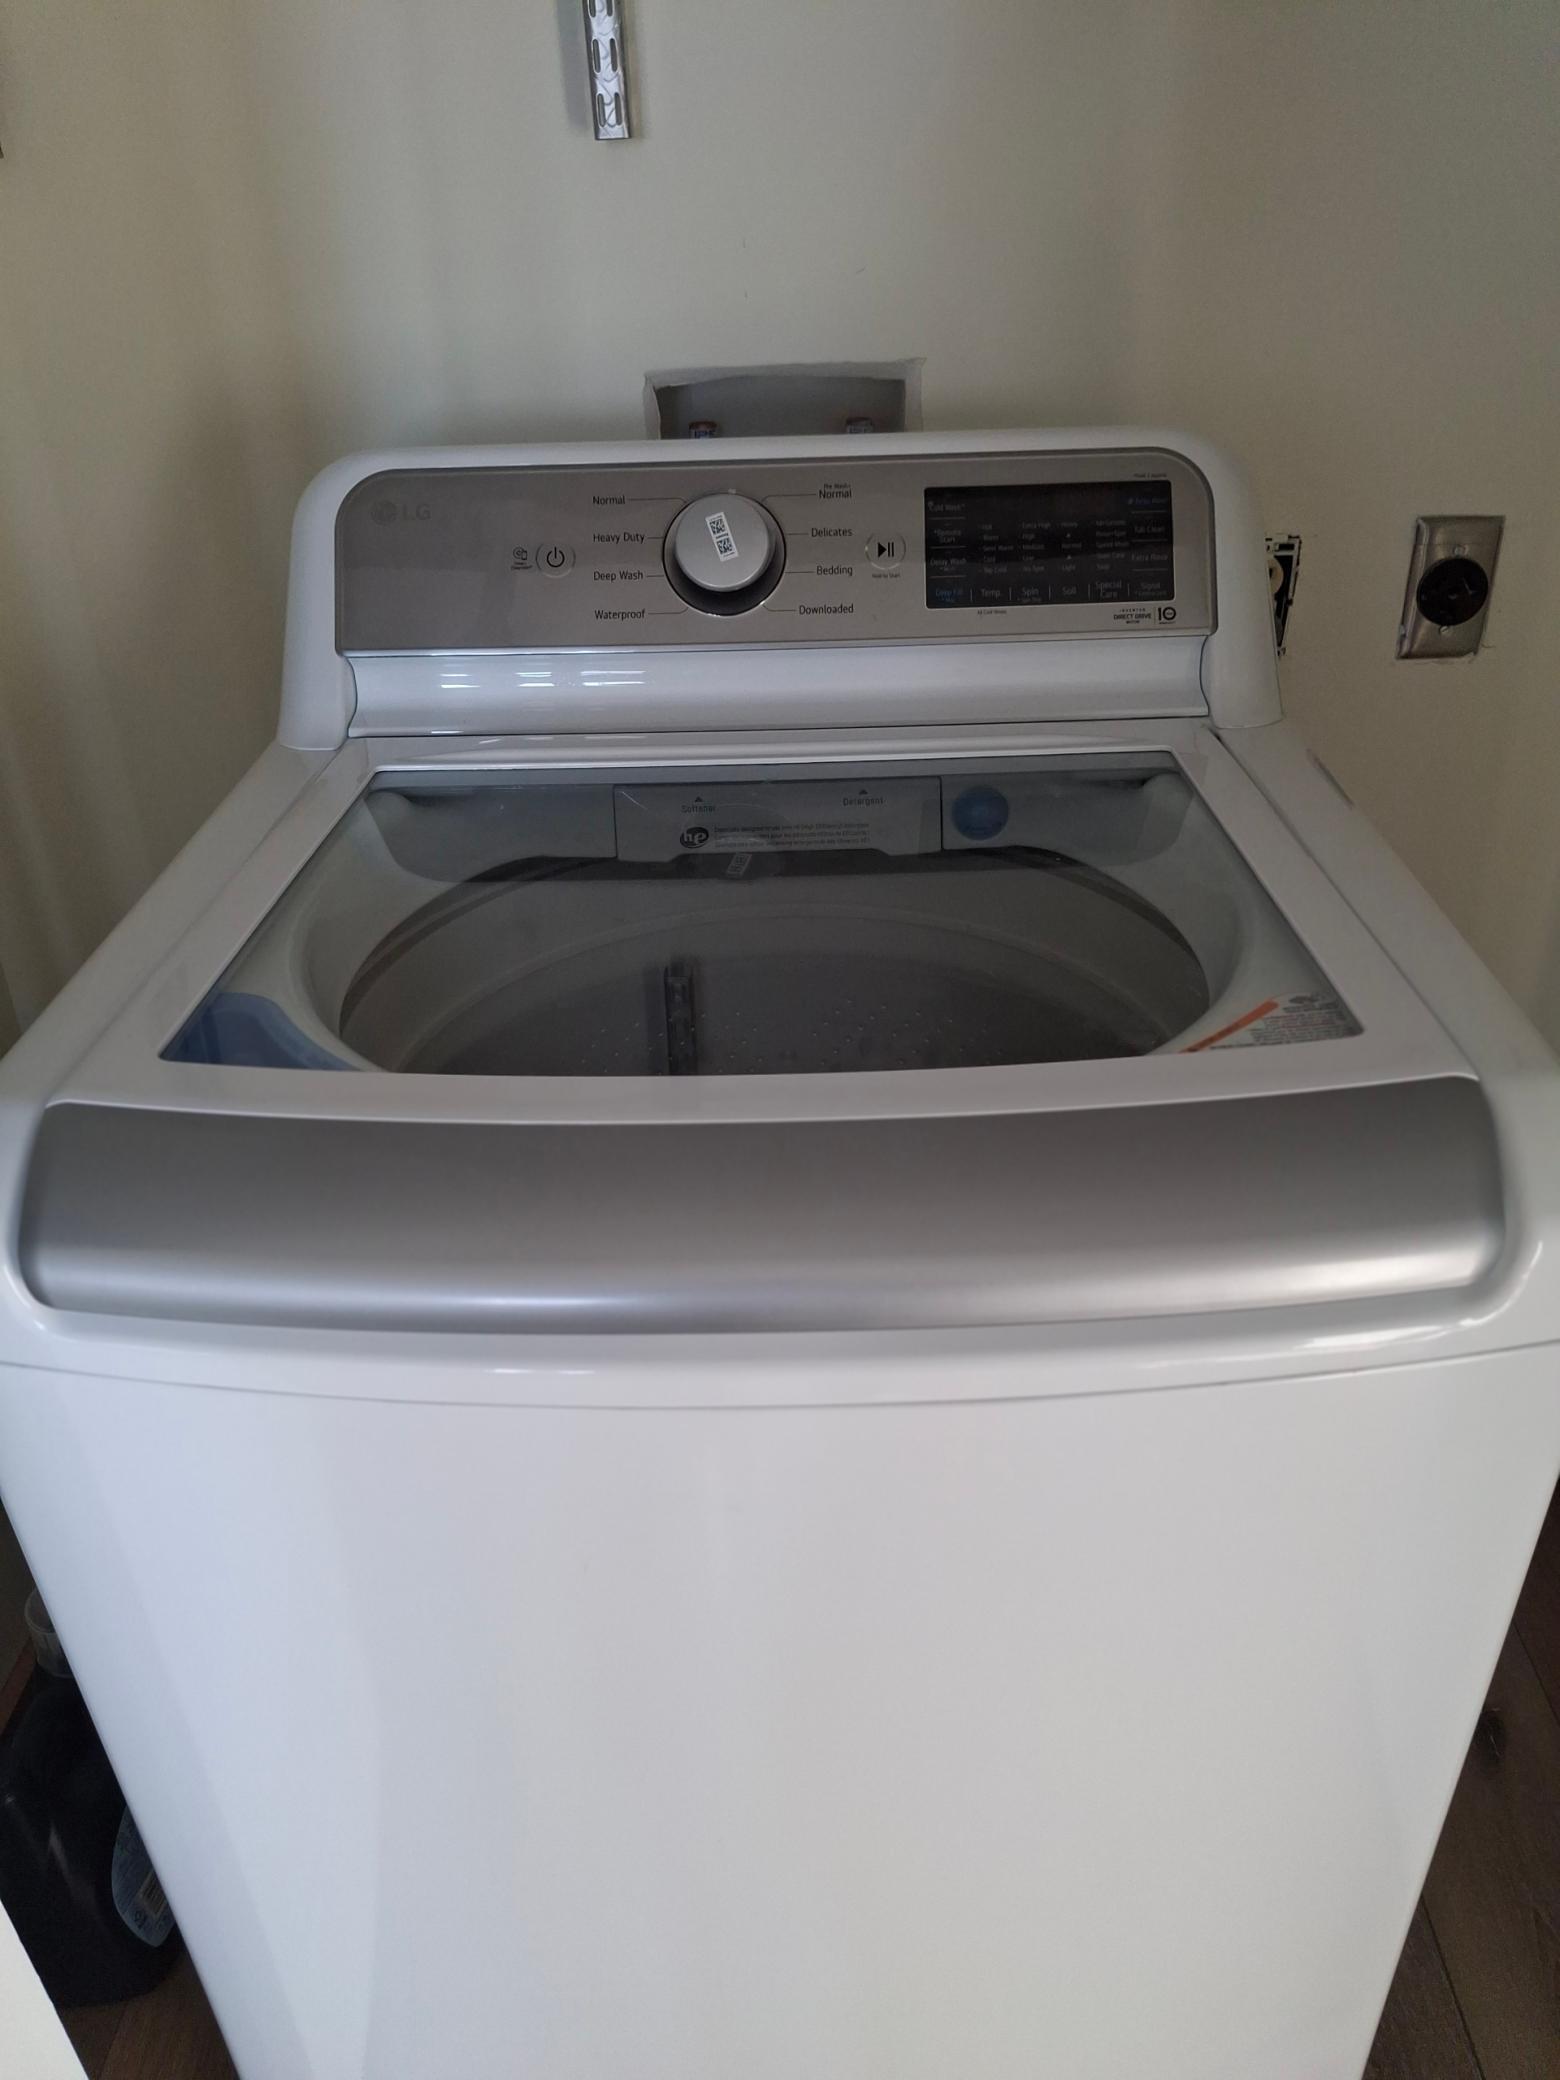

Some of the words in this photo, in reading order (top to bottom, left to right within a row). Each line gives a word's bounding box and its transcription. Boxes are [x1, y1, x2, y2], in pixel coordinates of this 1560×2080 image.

[818, 488, 852, 500] Normal
[592, 496, 625, 505] Normal
[402, 503, 431, 521] LG
[811, 526, 853, 537] Delicates
[592, 532, 620, 545] Heavy
[622, 532, 646, 545] Duty
[593, 571, 617, 582] Deep
[619, 570, 644, 581] Wash
[816, 565, 853, 577] Bedding
[1096, 580, 1122, 590] Special
[981, 588, 1001, 598] Temp
[1022, 586, 1040, 597] Spin
[1062, 586, 1077, 596] Soil
[1100, 590, 1118, 599] Care
[798, 602, 854, 614] Downloaded
[594, 608, 646, 622] Waterproof
[843, 797, 885, 808] Detergent
[680, 804, 716, 814] Softener
